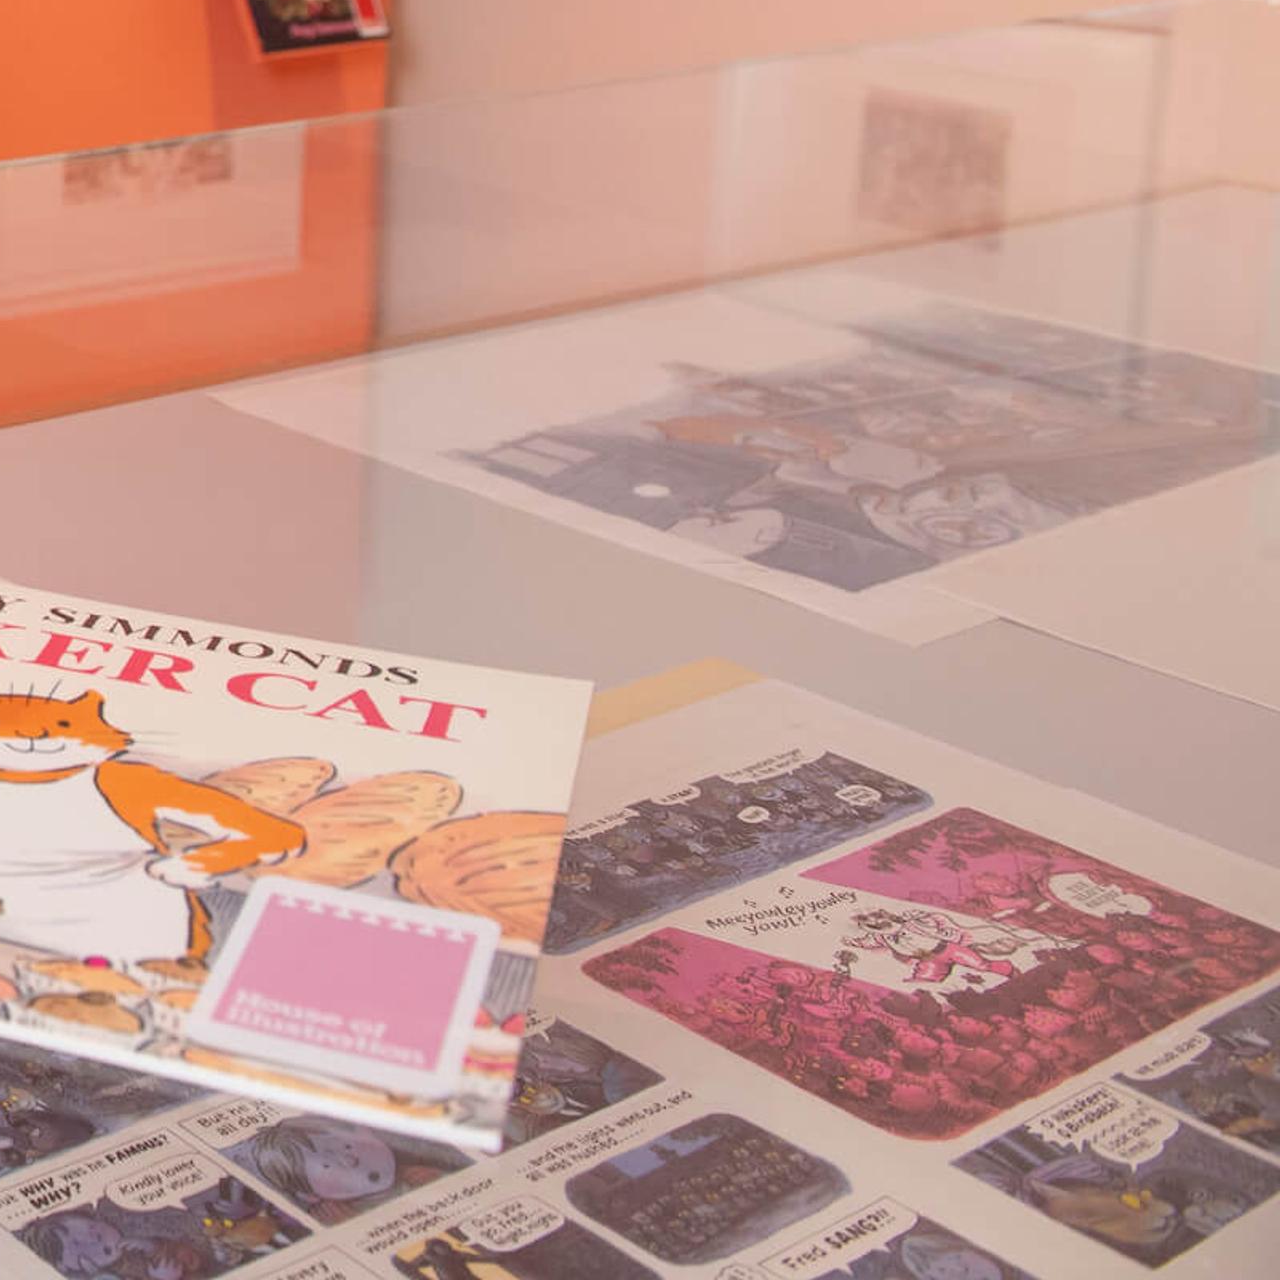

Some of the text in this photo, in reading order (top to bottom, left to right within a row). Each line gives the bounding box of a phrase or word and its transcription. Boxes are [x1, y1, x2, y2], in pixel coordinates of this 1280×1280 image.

[41, 604, 422, 687] SIMMONDS
[221, 670, 489, 744] CAT
[227, 1006, 426, 1065] Illustration
[235, 988, 386, 1039] House of
[18, 1176, 57, 1199] WHY
[103, 1133, 169, 1165] FAMOUS?
[780, 1243, 828, 1270] Fred
